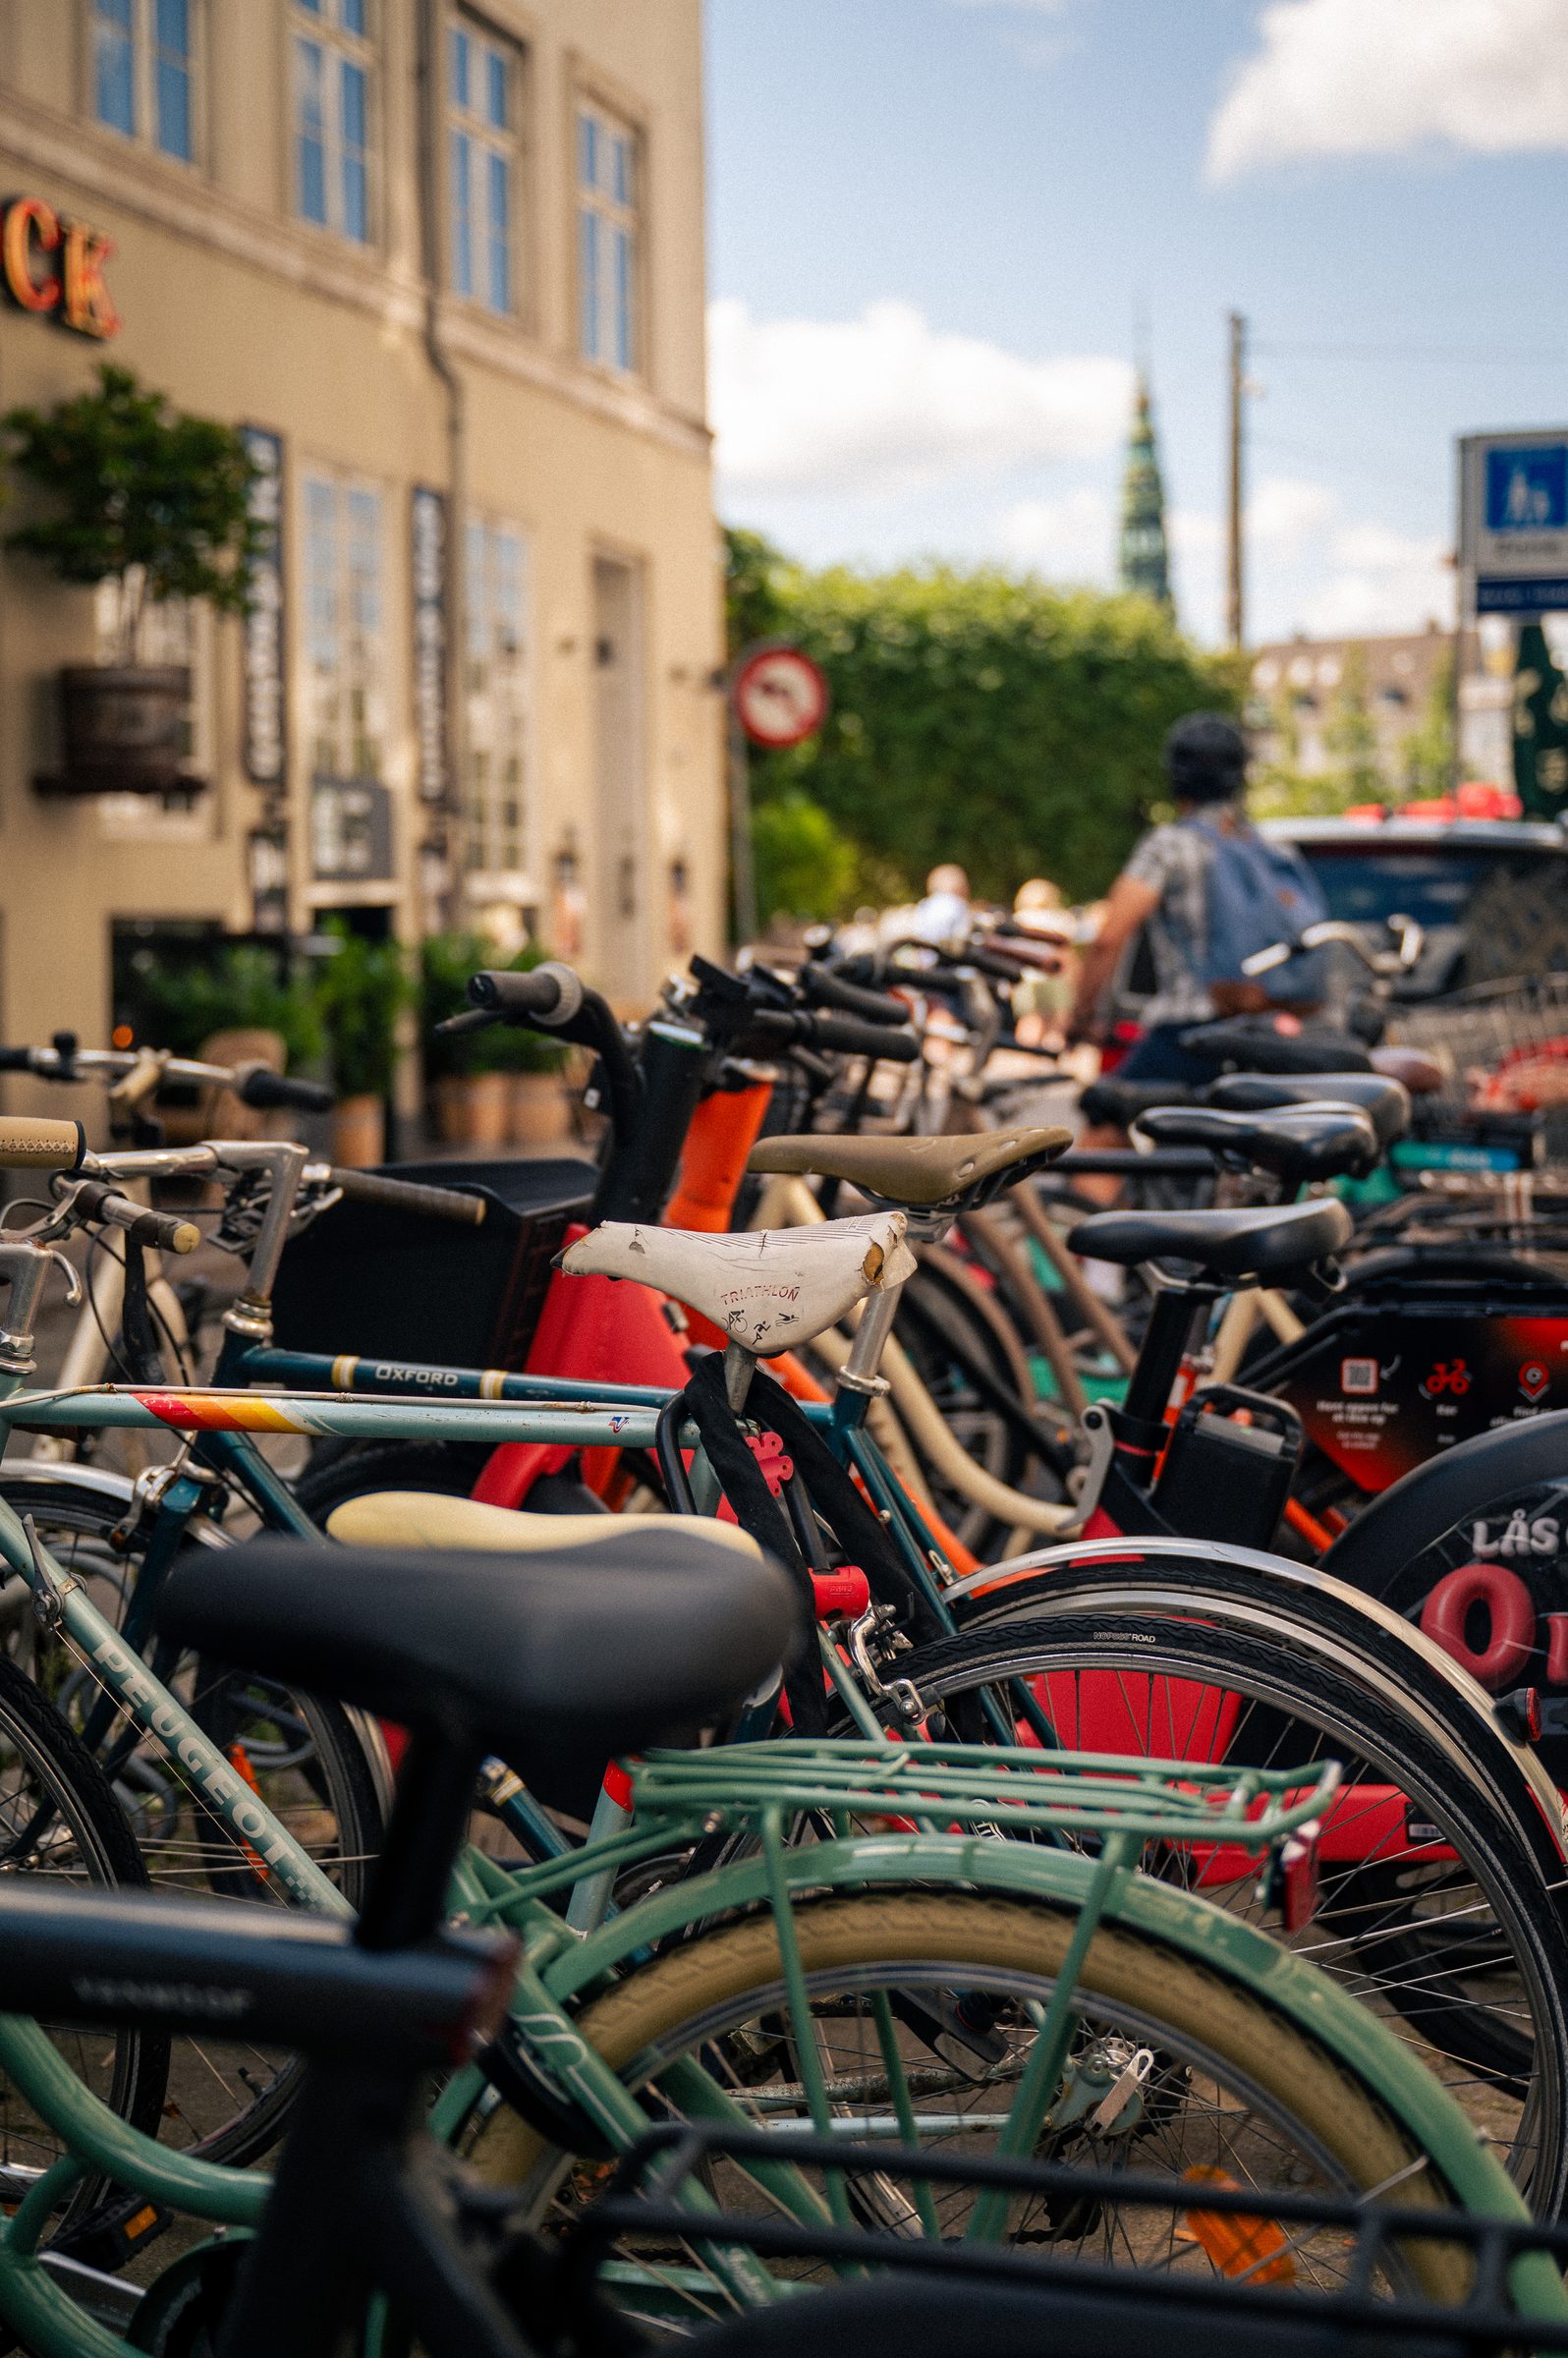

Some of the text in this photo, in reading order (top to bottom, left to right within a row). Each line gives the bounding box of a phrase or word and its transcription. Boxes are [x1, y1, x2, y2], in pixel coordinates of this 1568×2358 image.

[0, 196, 122, 337] CK
[374, 1364, 459, 1386] OXFORD
[1473, 1509, 1560, 1559] LÅS
[1131, 1633, 1156, 1644] ROAD
[92, 1638, 297, 1866] PEUGEOT
